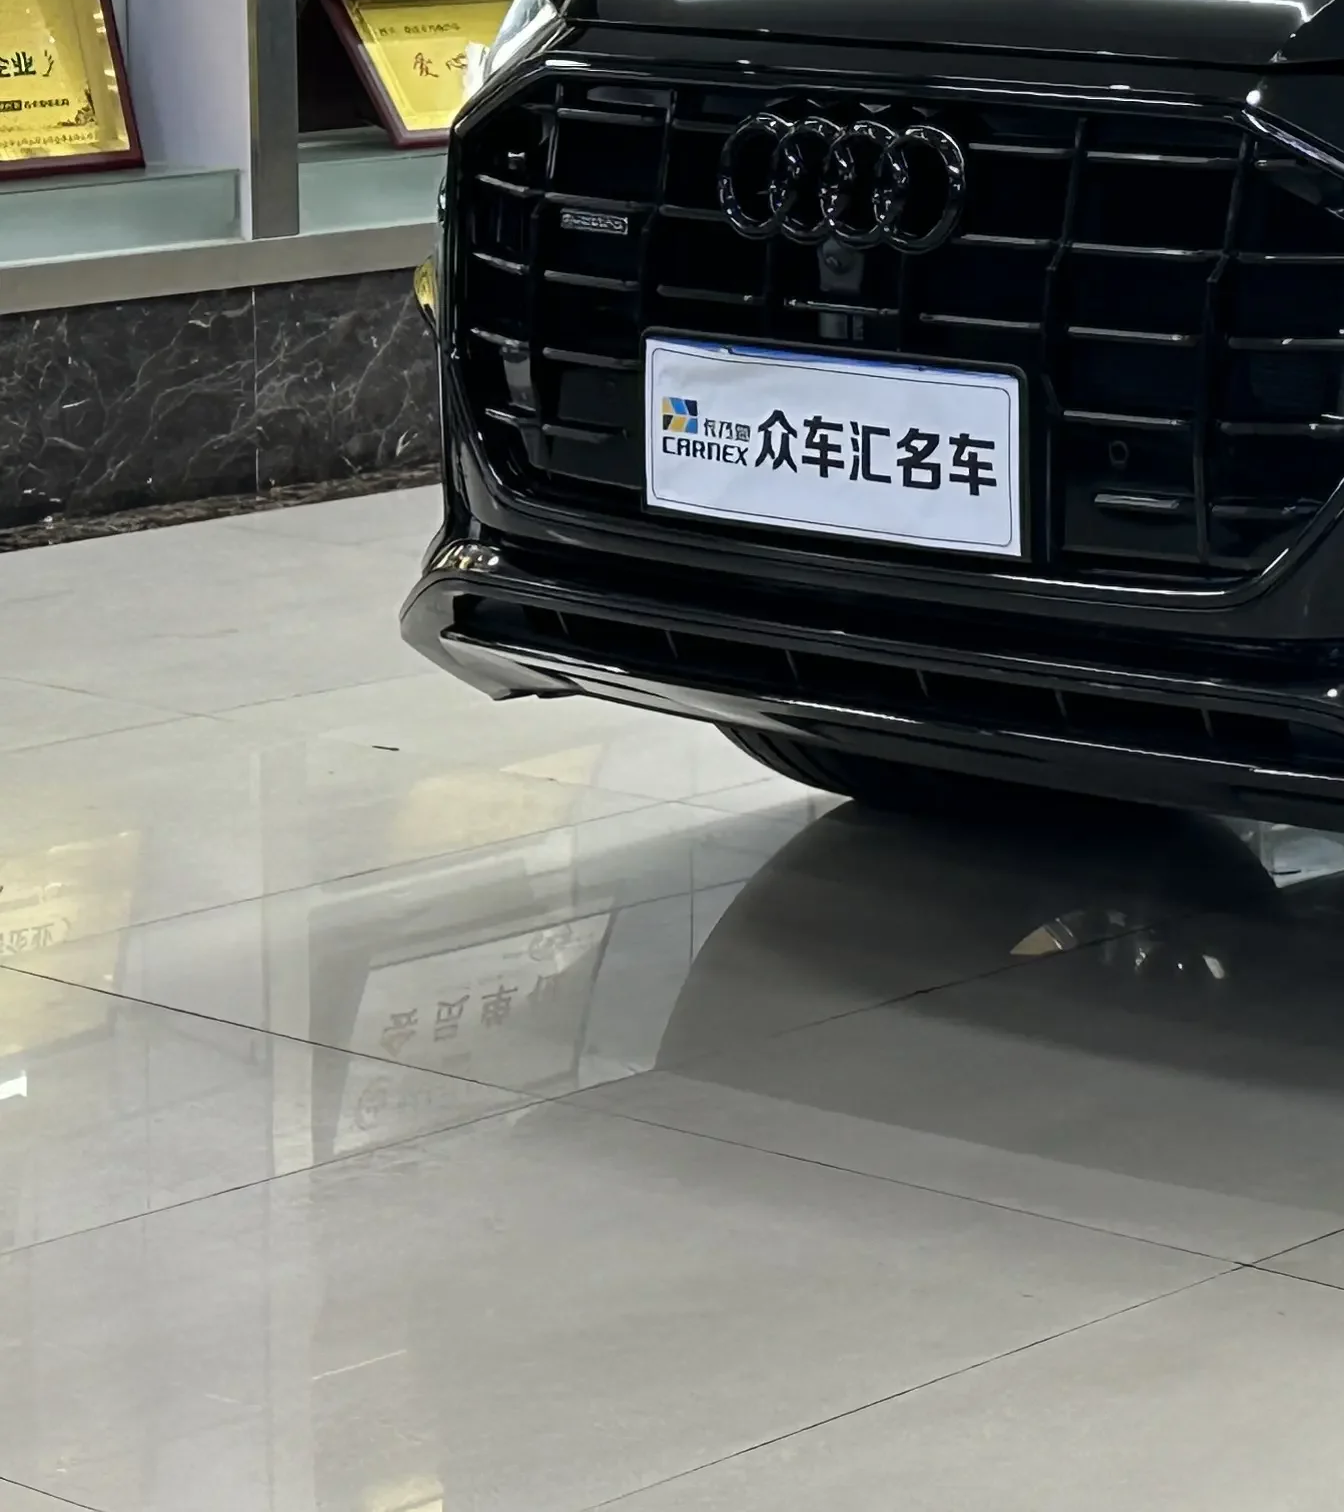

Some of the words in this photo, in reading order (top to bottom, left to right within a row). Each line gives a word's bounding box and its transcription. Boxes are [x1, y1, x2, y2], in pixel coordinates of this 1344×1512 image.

[662, 436, 749, 467] CARNEX
[755, 409, 998, 497] 众车汇名车
